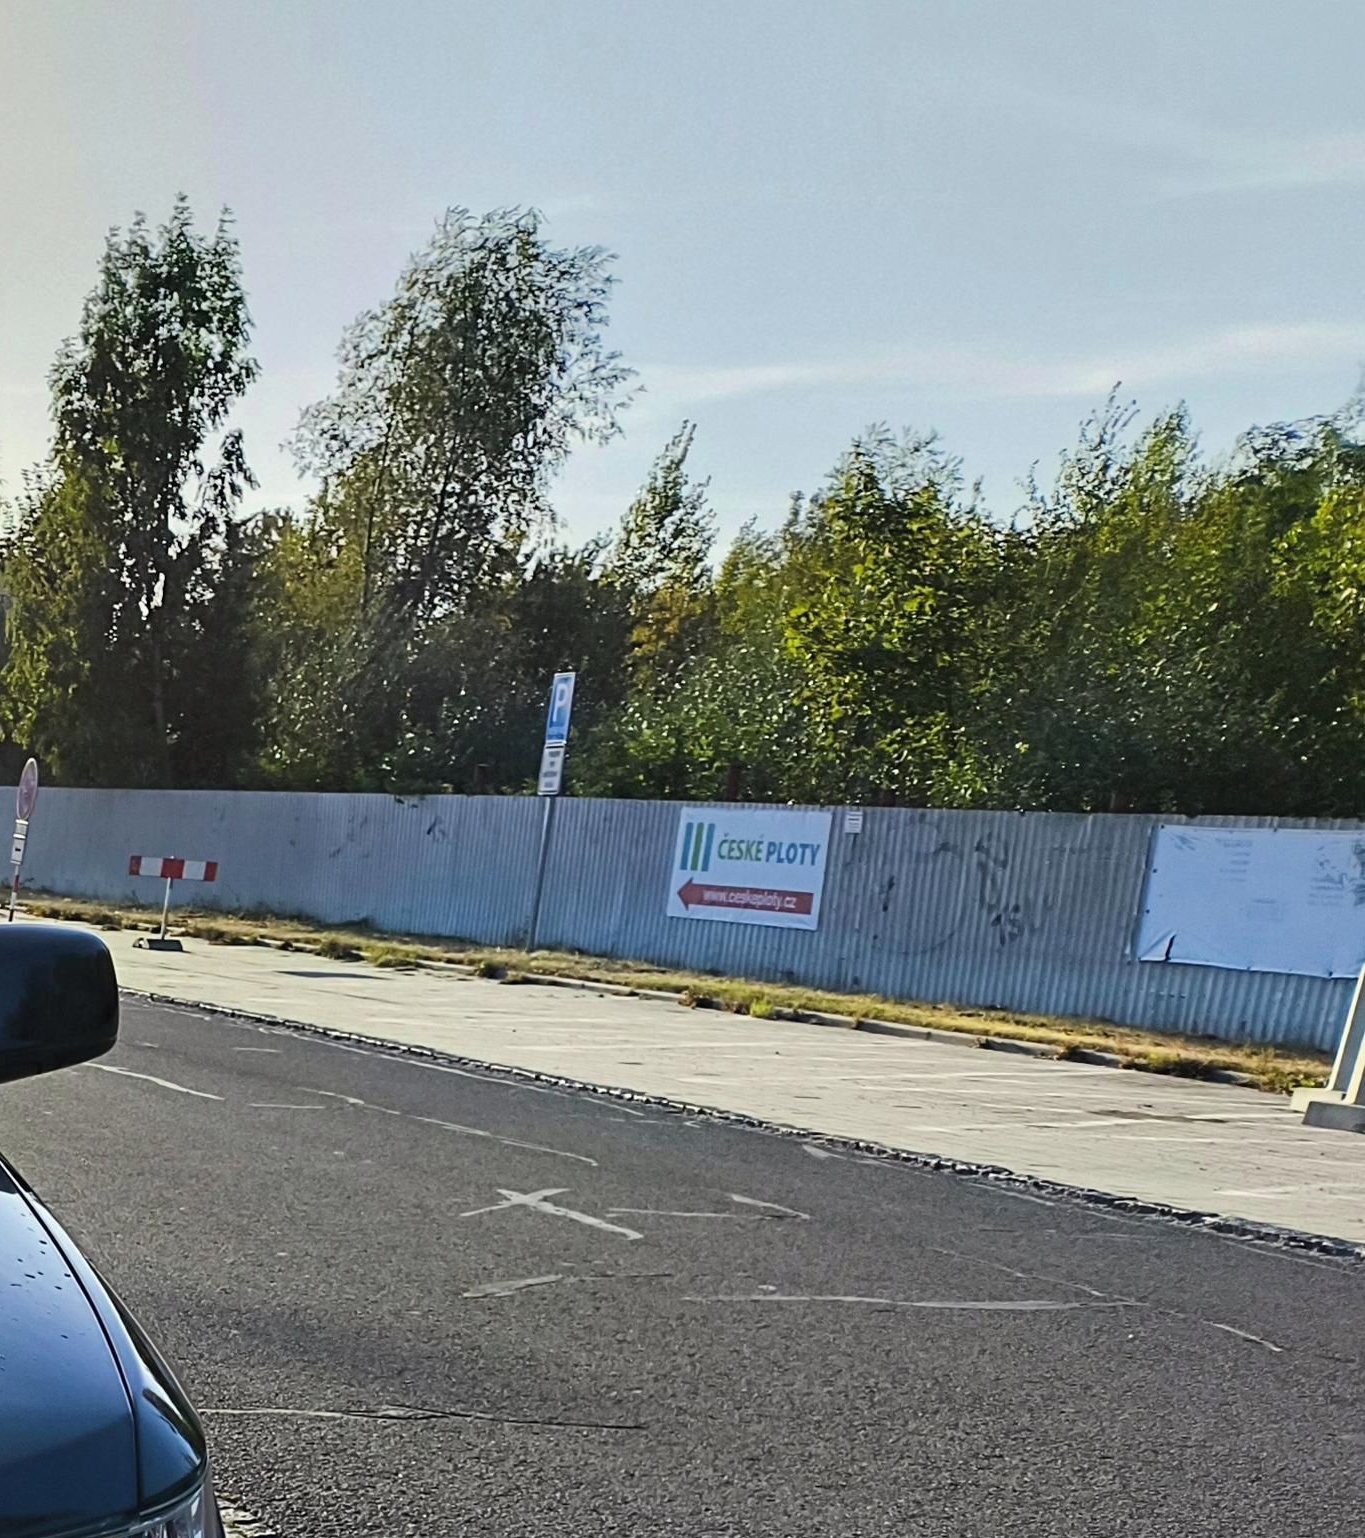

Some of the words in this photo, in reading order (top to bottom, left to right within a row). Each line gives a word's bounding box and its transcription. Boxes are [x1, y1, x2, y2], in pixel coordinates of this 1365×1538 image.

[553, 683, 567, 722] P
[717, 833, 764, 862] ČESKÉ
[765, 841, 821, 866] PLOTY
